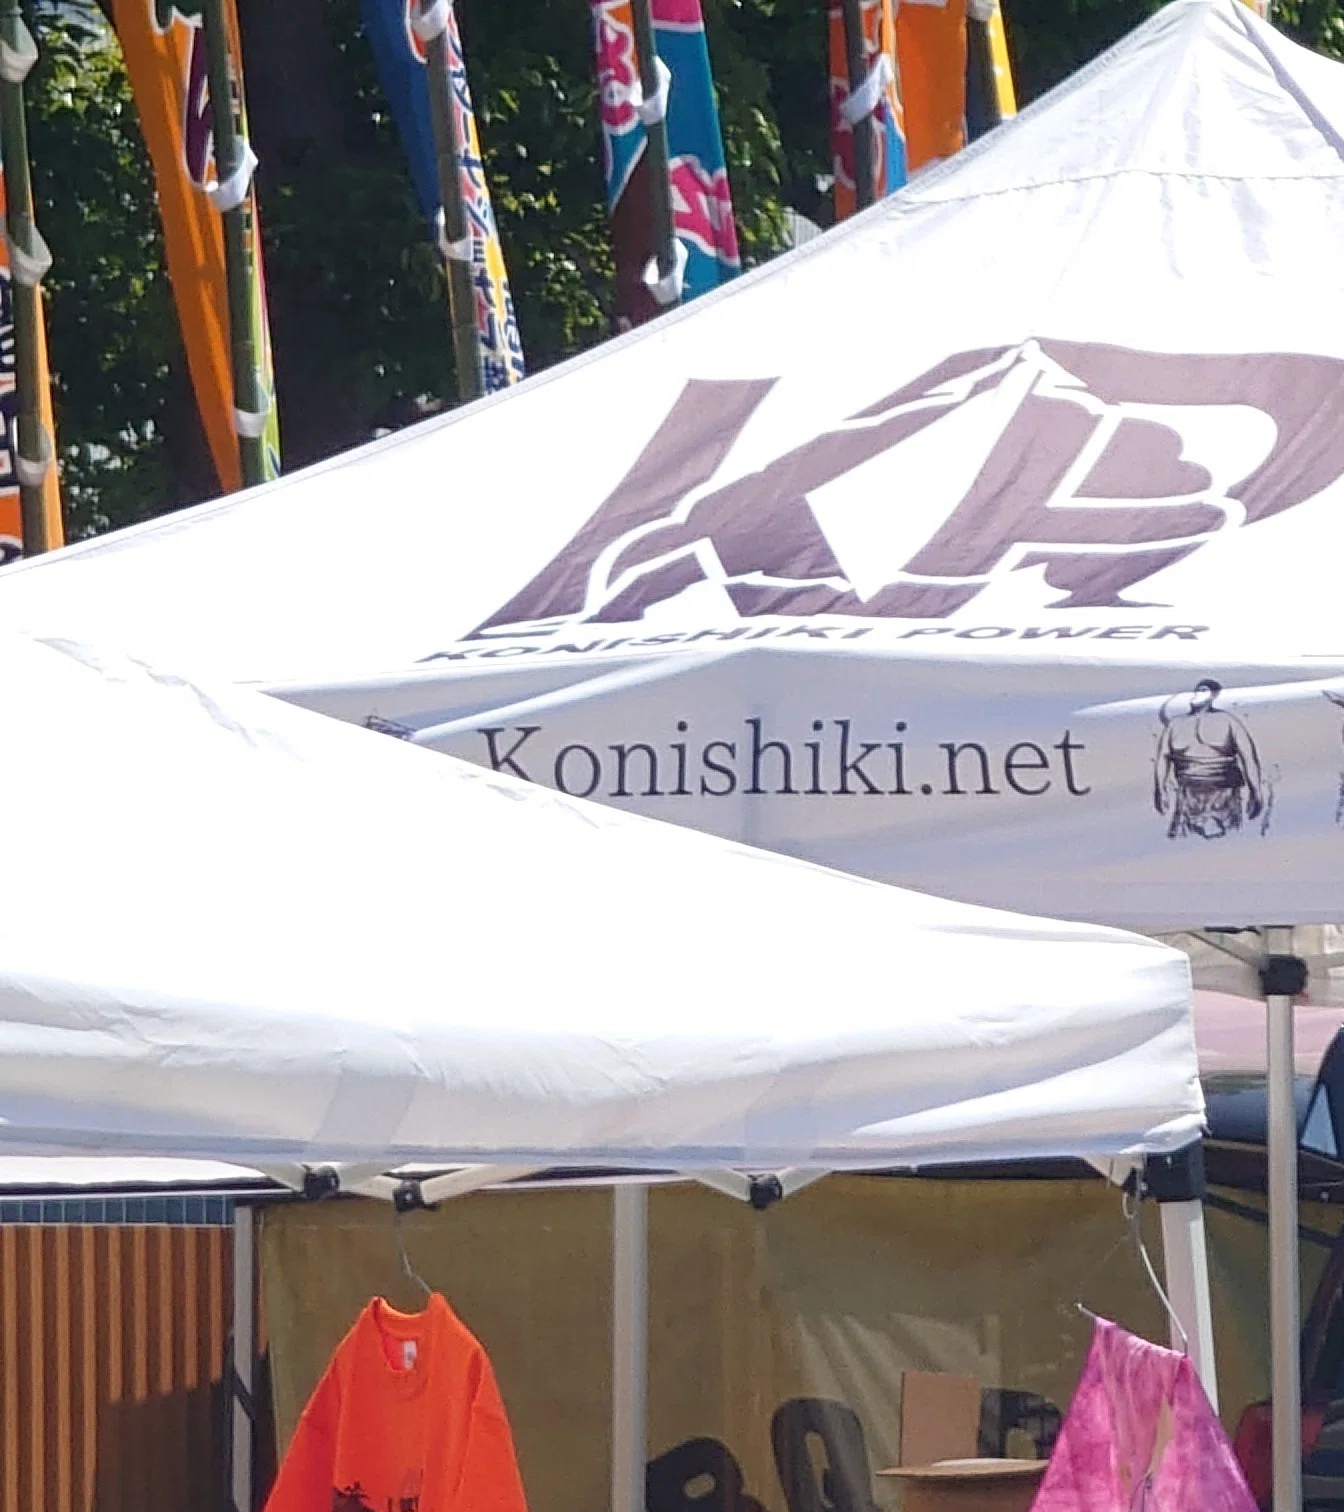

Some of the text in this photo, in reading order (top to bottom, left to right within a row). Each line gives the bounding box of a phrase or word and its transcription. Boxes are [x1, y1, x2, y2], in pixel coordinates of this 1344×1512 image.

[414, 624, 1211, 663] KONISHIKI POWER
[477, 716, 1091, 798] Konishiki.net
